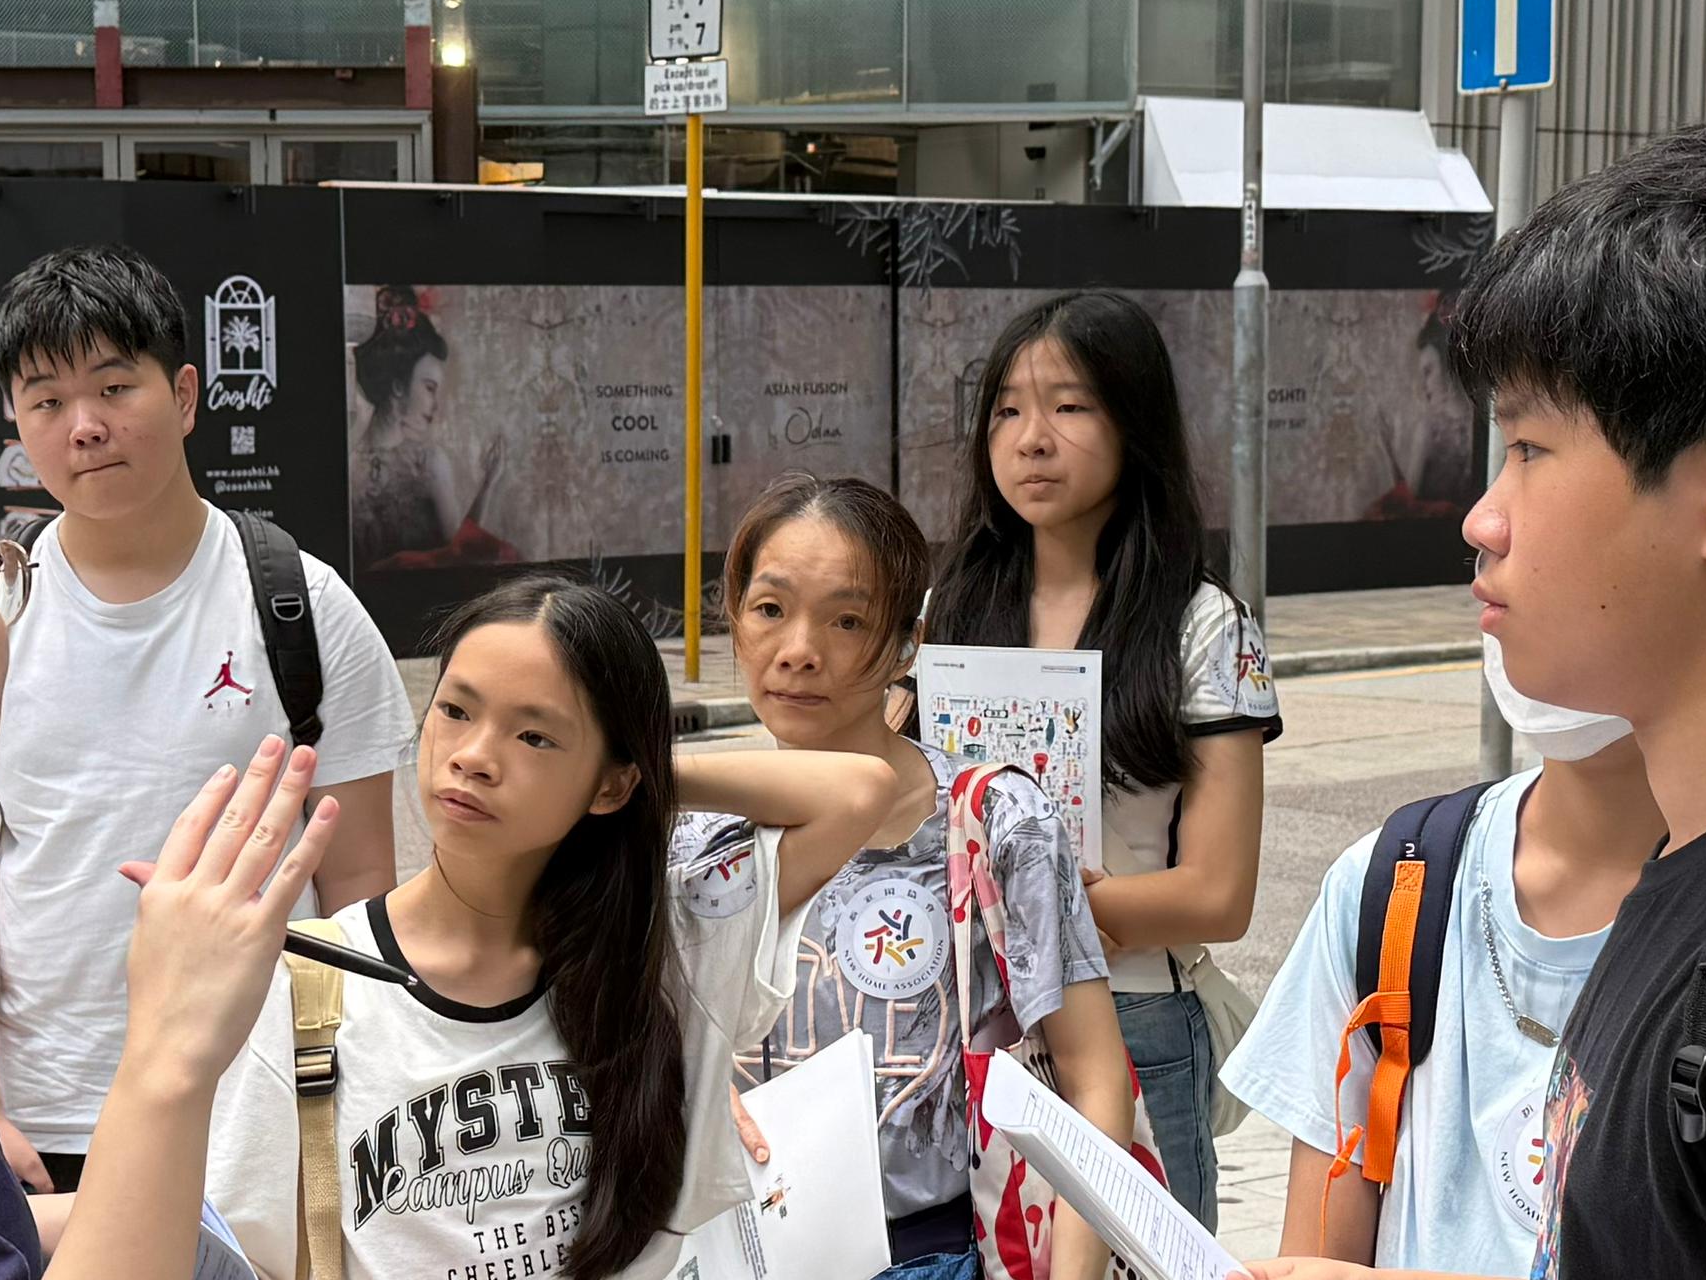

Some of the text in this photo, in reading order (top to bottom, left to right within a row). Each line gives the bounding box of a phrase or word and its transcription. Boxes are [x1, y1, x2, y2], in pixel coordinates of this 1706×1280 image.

[696, 22, 705, 46] 7
[207, 375, 273, 411] Cooshti
[596, 384, 673, 398] SOMETHING
[764, 382, 849, 397] ASIAN FUSION
[611, 415, 658, 432] COOL
[601, 449, 669, 463] IS COMING
[858, 972, 888, 990] HOME
[893, 939, 944, 991] ASSOCIATION
[350, 1059, 593, 1232] MYSTE
[1500, 1151, 1512, 1183] NEW
[382, 1159, 535, 1225] Campus
[474, 1222, 527, 1253] THE
